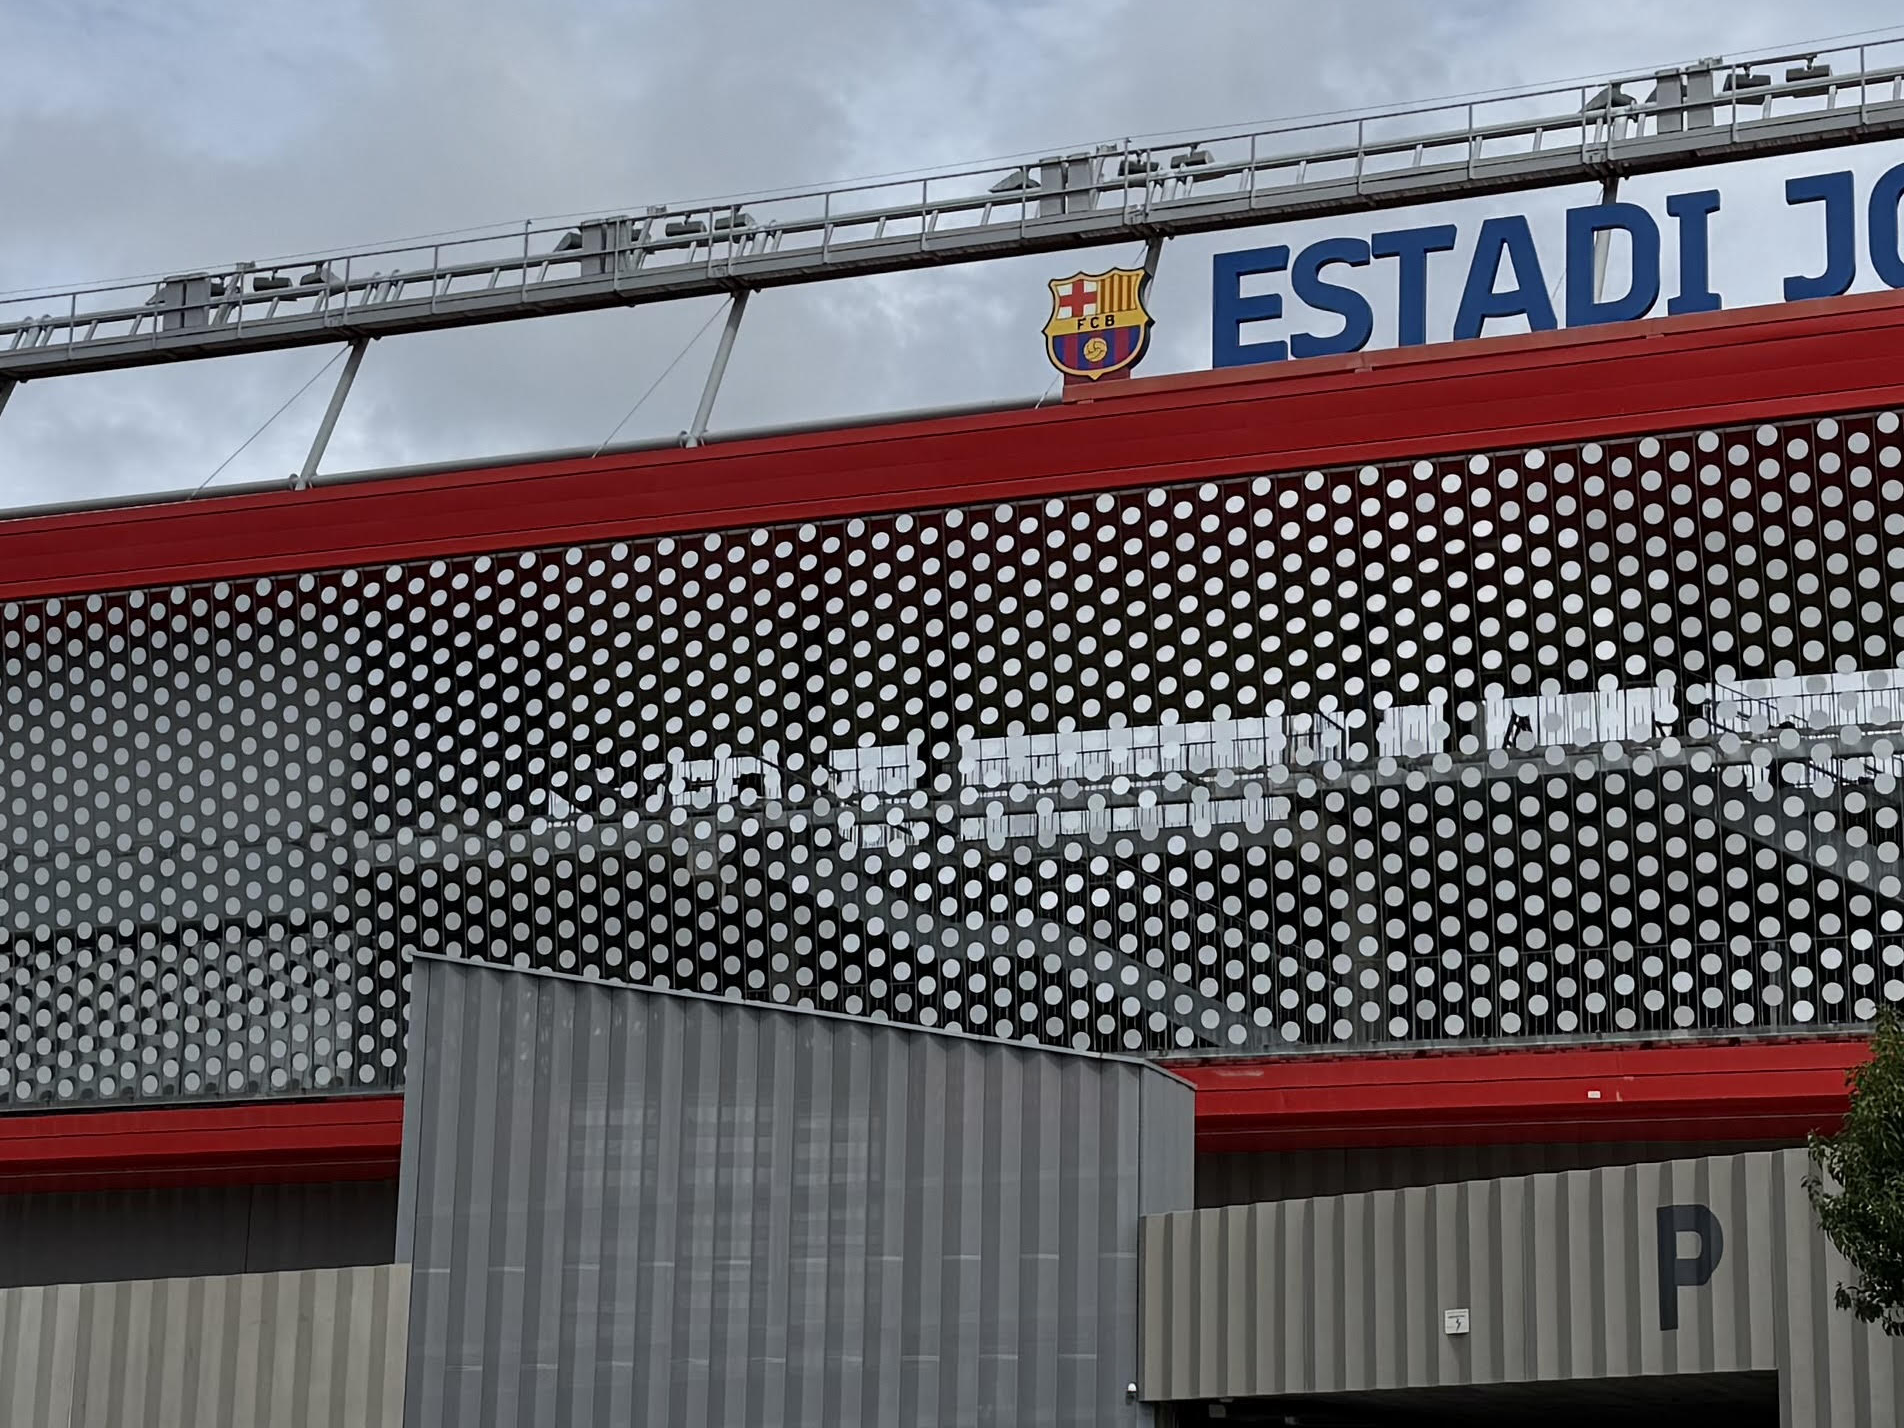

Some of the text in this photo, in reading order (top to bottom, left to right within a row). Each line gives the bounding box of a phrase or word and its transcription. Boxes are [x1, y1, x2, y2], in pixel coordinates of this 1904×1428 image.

[1077, 315, 1116, 331] FCB
[1212, 189, 1722, 369] ESTADI
[1656, 1204, 1724, 1331] P
